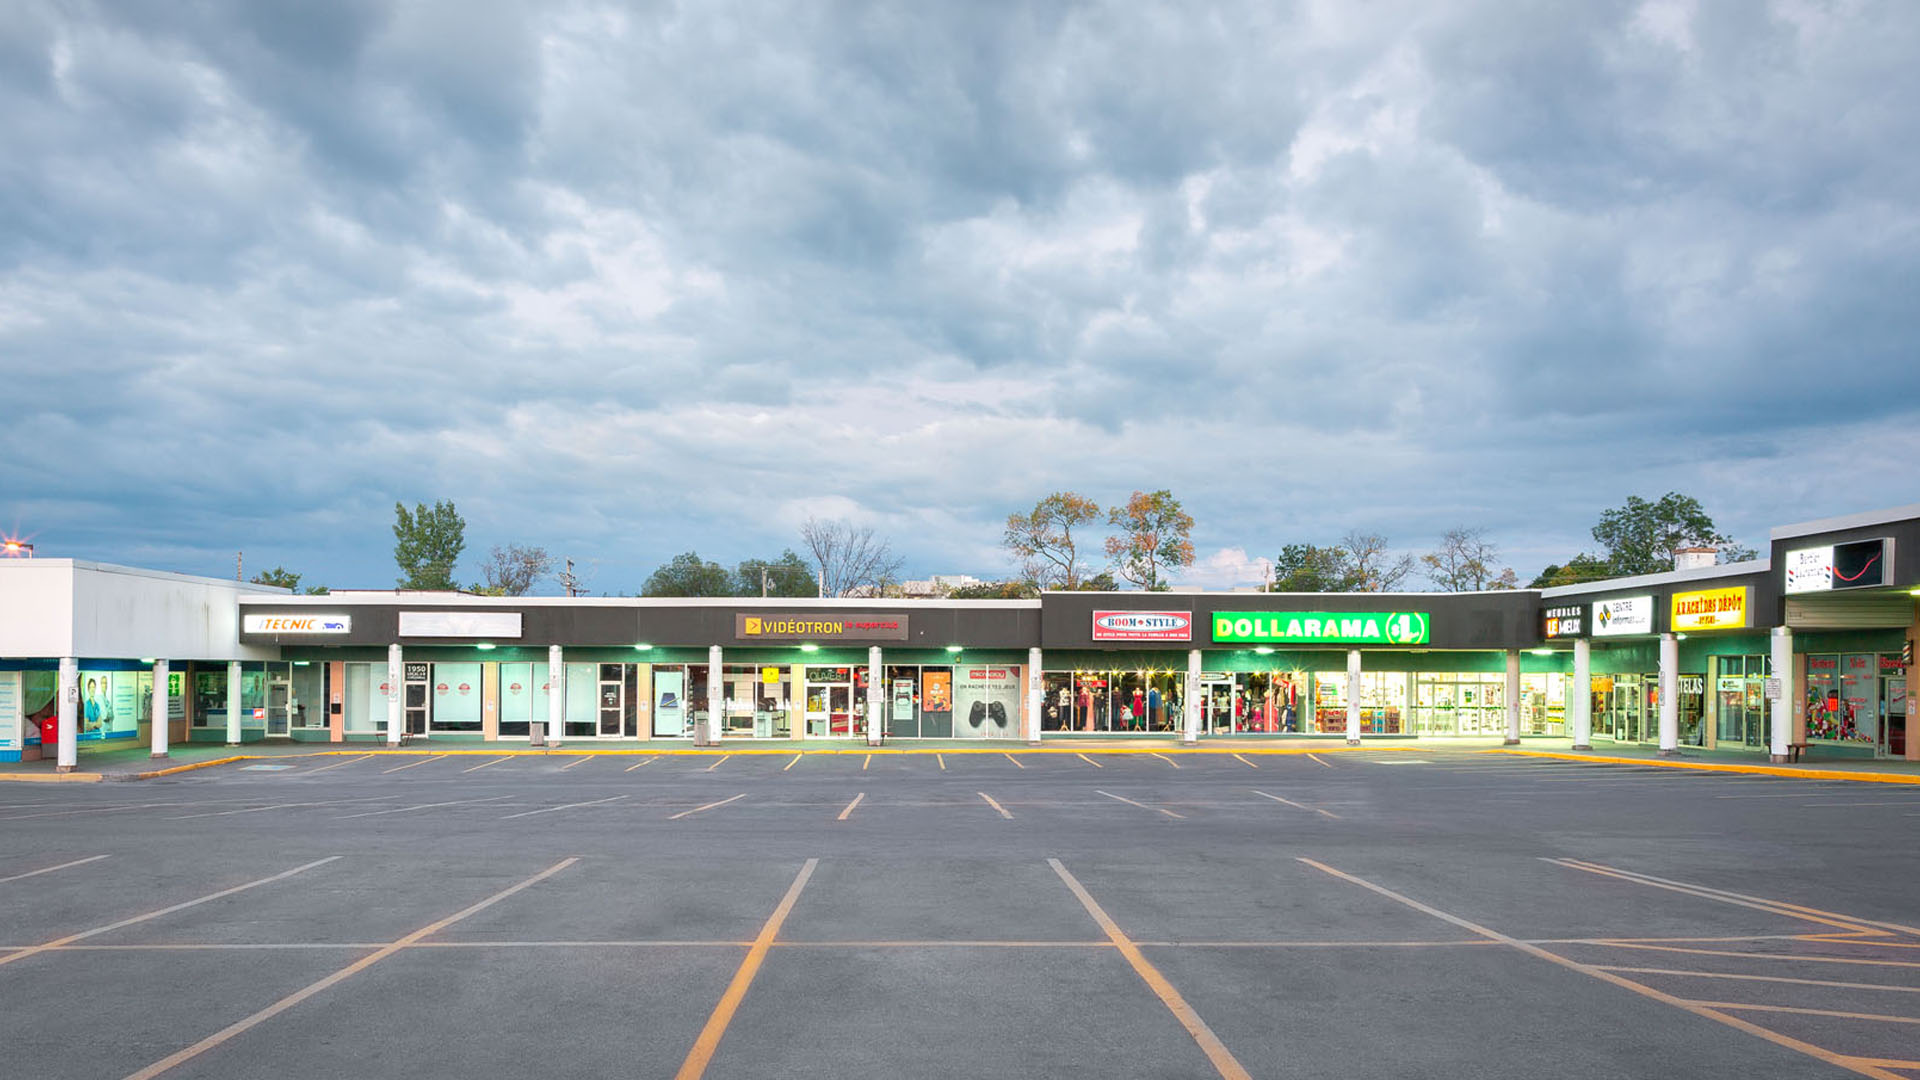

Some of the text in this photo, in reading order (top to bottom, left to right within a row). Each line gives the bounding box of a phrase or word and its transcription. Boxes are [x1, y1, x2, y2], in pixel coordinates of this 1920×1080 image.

[764, 618, 842, 634] VIDÉOTRON
[1108, 618, 1178, 627] BOOM STYLE
[1216, 619, 1380, 637] DOLLARAMA
[1678, 678, 1703, 694] TELAS
